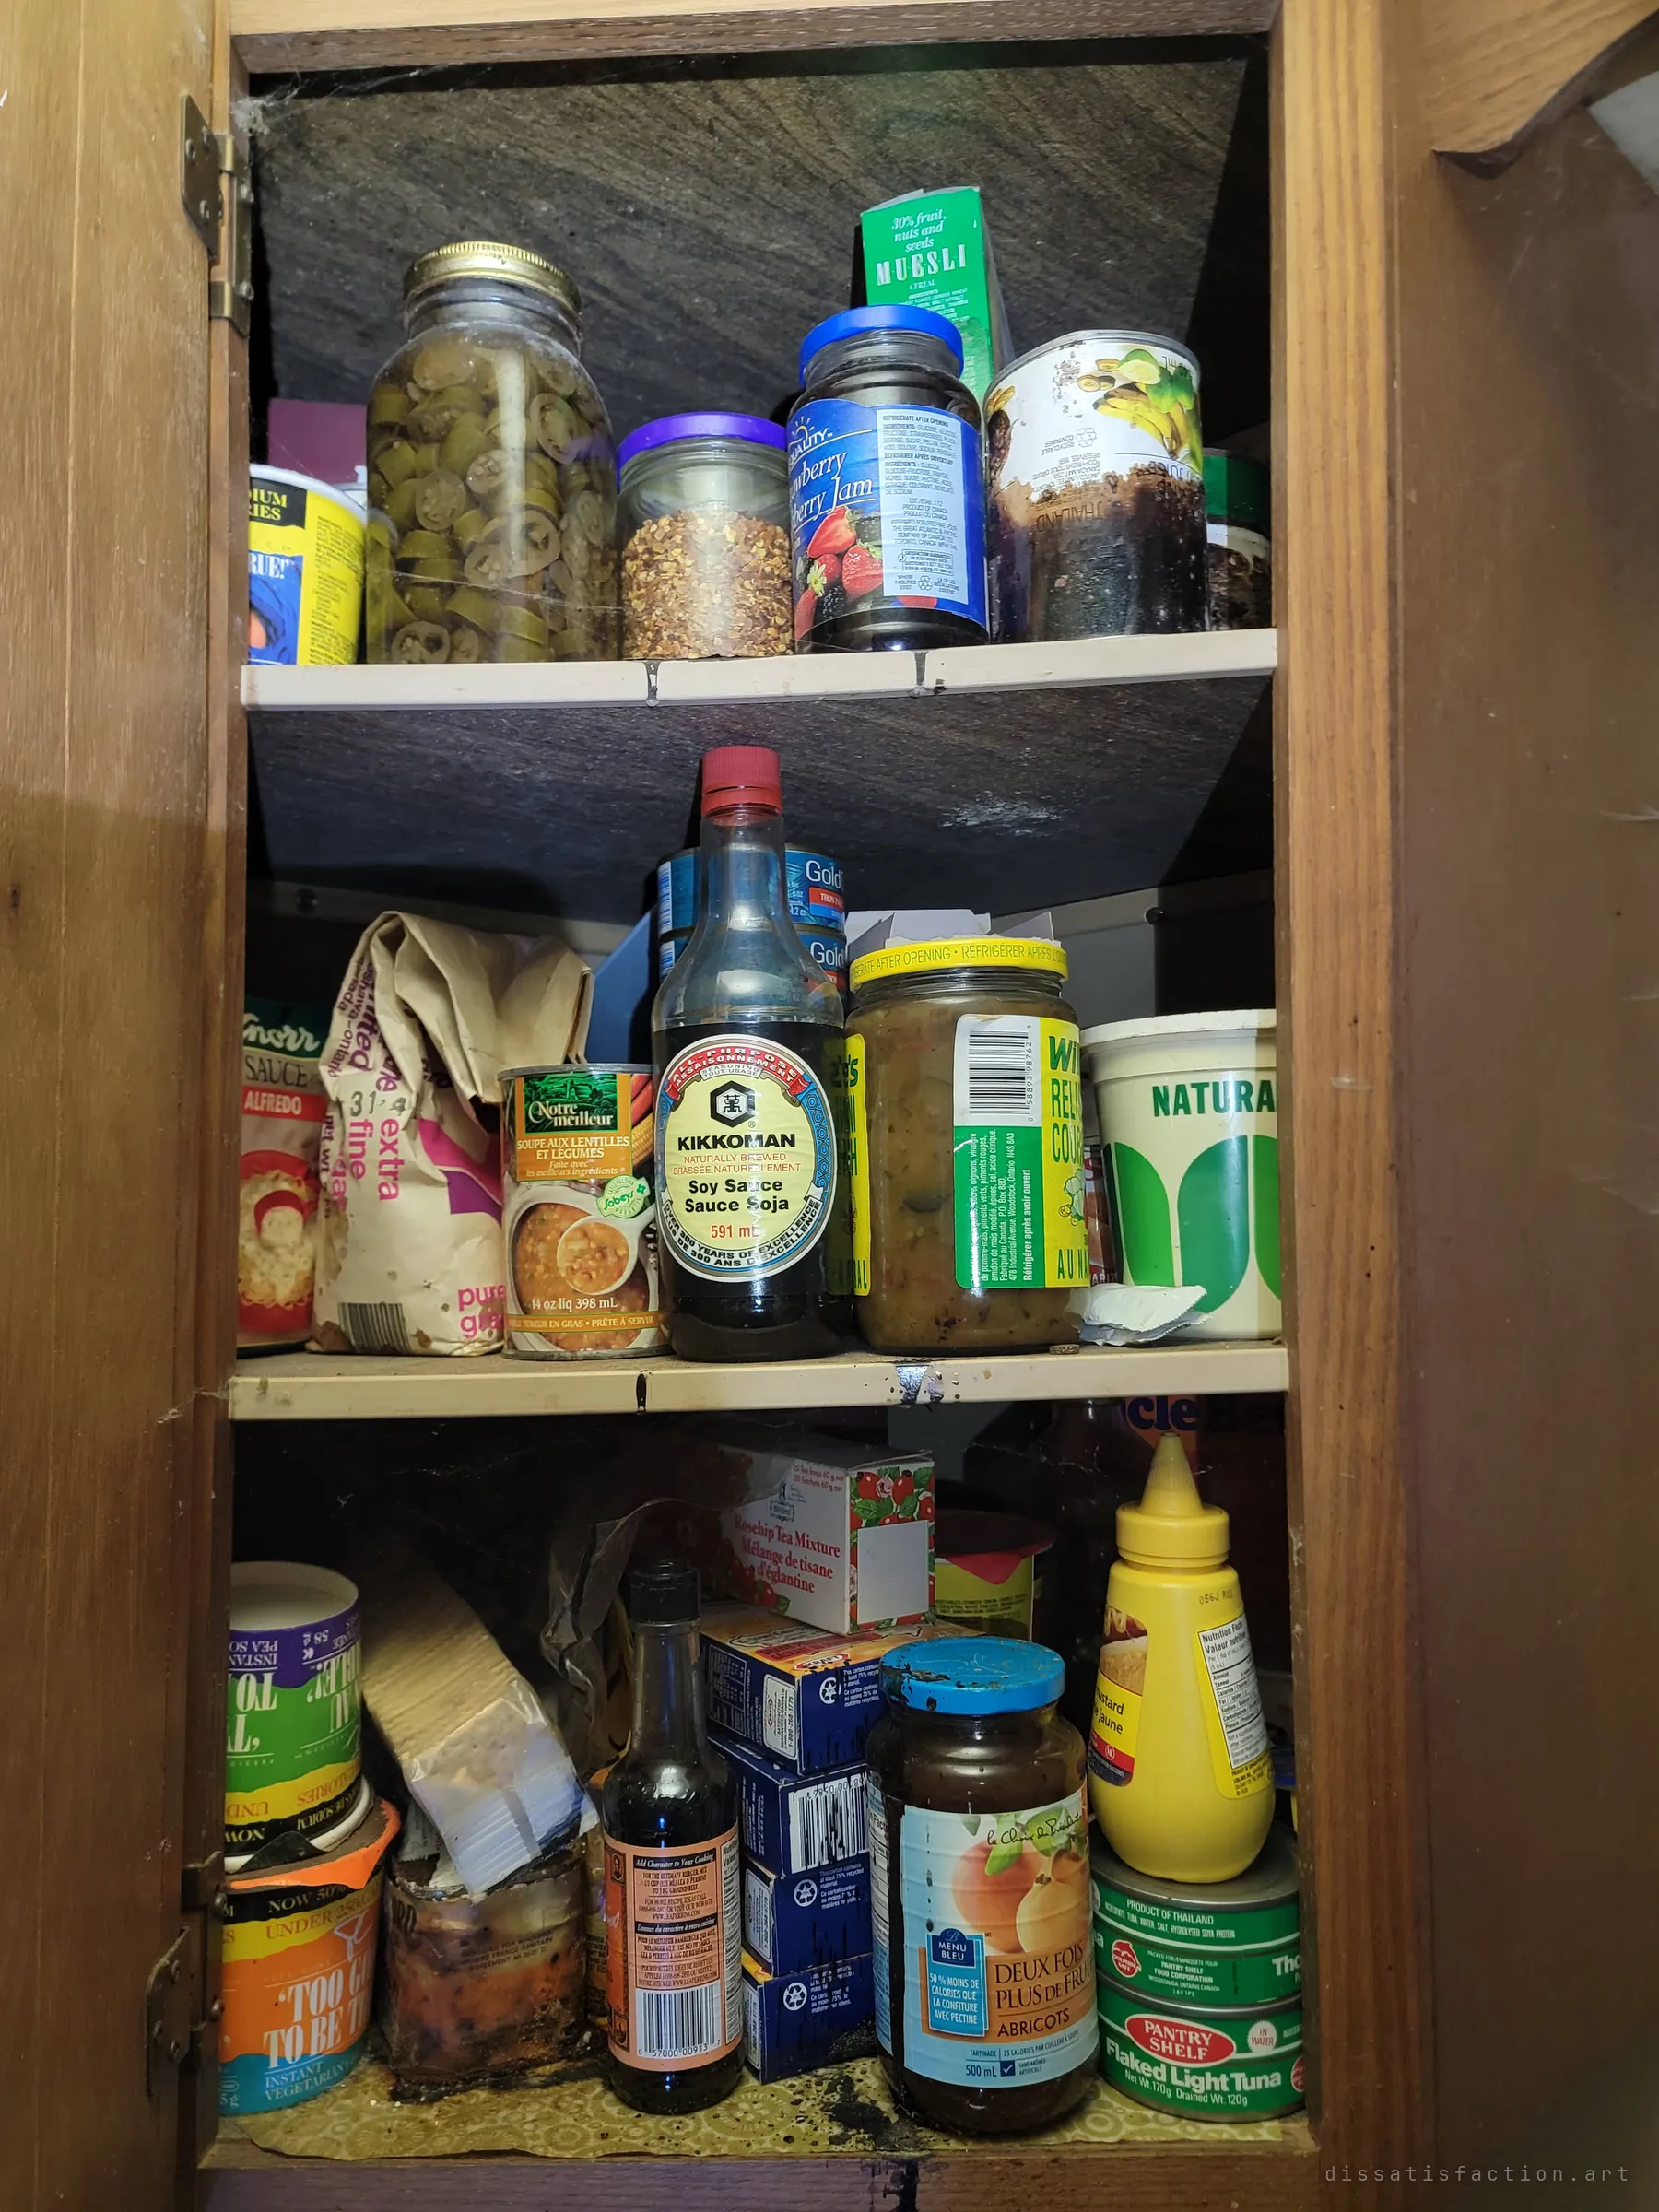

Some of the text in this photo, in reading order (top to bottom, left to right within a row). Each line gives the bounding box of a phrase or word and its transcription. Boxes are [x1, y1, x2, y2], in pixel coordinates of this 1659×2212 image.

[892, 208, 947, 230] 30% fruit,
[895, 220, 943, 242] nuts and
[905, 237, 935, 253] seeds
[875, 243, 967, 287] MUESLI
[877, 953, 901, 970] AFTER
[902, 947, 951, 966] OPENING
[244, 1054, 308, 1088] SAUCE
[672, 1047, 797, 1082] ALL-PURPOSE
[675, 1054, 794, 1088] ASSAISONNEMENT
[704, 1068, 759, 1080] TOUT USAGE
[1025, 1041, 1034, 1105] 58893 98762
[243, 1089, 303, 1116] ALFREDO
[528, 1100, 578, 1124] Notre
[553, 1110, 614, 1127] meilleur
[348, 1118, 374, 1181] fine
[517, 1135, 630, 1150] SOUPE AUX LENTILLES
[535, 1146, 605, 1160] ET LÉGUMES
[677, 1134, 796, 1151] KIKKOMAN
[378, 1117, 406, 1202] extra
[673, 1164, 712, 1175] BRASSÉE
[684, 1153, 787, 1164] NATURALLY BREWED
[1006, 1160, 1016, 1182] Ontario
[688, 1178, 783, 1196] Soy Sauce
[684, 1195, 790, 1214] Sauce Soja
[679, 1228, 696, 1248] 300
[698, 1244, 735, 1260] YEARS
[759, 1198, 818, 1254] EXCELLENCE
[711, 1224, 734, 1239] 591
[1021, 1169, 1034, 1281] Réfrigérer après avoir ouvert
[1008, 1241, 1018, 1269] Industrial
[1008, 1269, 1018, 1281] 478
[531, 1297, 618, 1313] 14 oz liq 398 mL
[735, 1514, 841, 1558] Rosehip Tea Mixture
[741, 1536, 834, 1579] Mélange de tisane
[757, 1564, 815, 1594] d'églantine
[1202, 1626, 1232, 1643] Nutrition
[1205, 1641, 1229, 1654] Valeur
[1097, 1709, 1124, 1735] jaune
[635, 1859, 646, 1867] Add
[681, 1858, 693, 1866] Your
[694, 1853, 714, 1864] Cooking
[268, 1892, 314, 1914] NOW
[1126, 1898, 1215, 1925] PRODUCT OF THAILAND
[265, 1911, 334, 1939] UNDER
[938, 1942, 966, 1952] MENU
[941, 1950, 965, 1961] BLEU
[995, 1940, 1084, 1983] DEUX FOIS
[1160, 1961, 1204, 1975] PANTRY SHELF
[929, 1972, 979, 1989] 50 % MOINS DE
[1154, 1967, 1214, 1983] FOOD CORPORATION
[931, 1986, 977, 2001] CALORIES QUE
[996, 1984, 1042, 2009] PLUS
[1044, 1982, 1062, 2002] DE
[933, 1997, 978, 2013] LA CONFITURE
[934, 2010, 978, 2024] AVEC PECTINE
[997, 2007, 1070, 2037] ABRICOTS
[263, 2006, 344, 2069] TO BE
[1143, 2019, 1213, 2047] PANTRY
[1250, 2035, 1276, 2048] WATER
[1258, 2027, 1268, 2037] IN
[653, 2049, 679, 2058] 57000
[682, 2044, 709, 2056] 00913
[970, 2049, 997, 2058] TARTINADE
[1004, 2049, 1010, 2057] 25
[1010, 2045, 1034, 2056] CALORIES
[1035, 2042, 1044, 2052] PAR
[1148, 2038, 1208, 2061] SHELF
[265, 2061, 324, 2088] INSTANT
[965, 2065, 997, 2077] 500 mL
[1106, 2036, 1282, 2094] Flaked Light Tuna
[265, 2065, 346, 2101] VEGETARIAN
[1124, 2068, 1138, 2084] Net
[1175, 2087, 1208, 2104] Drained
[1210, 2094, 1226, 2106] Wt.
[1227, 2095, 1248, 2107] 120g
